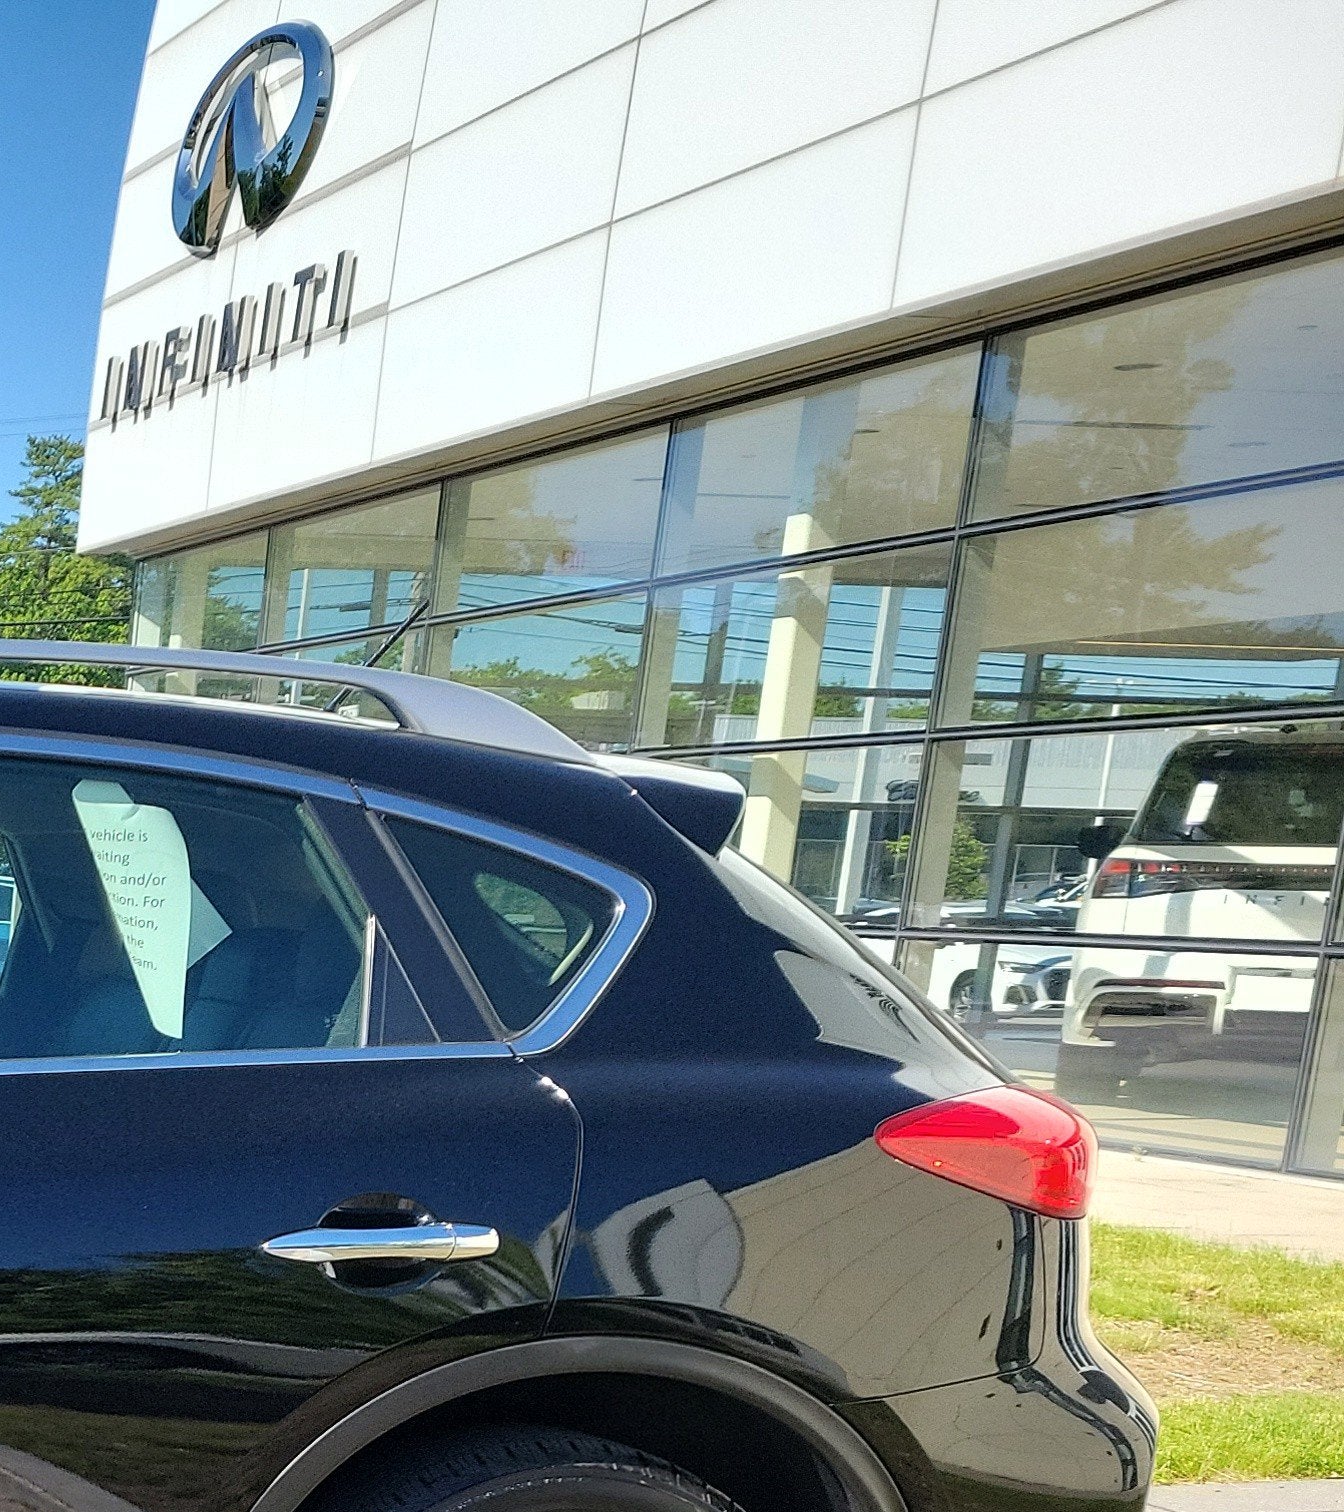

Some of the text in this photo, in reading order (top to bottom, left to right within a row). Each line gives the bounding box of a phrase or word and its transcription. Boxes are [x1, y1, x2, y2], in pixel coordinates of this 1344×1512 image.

[100, 249, 356, 422] INFINITI
[90, 829, 148, 842] vehicle is
[120, 873, 167, 886] and/or
[143, 896, 165, 908] For
[127, 935, 144, 948] the
